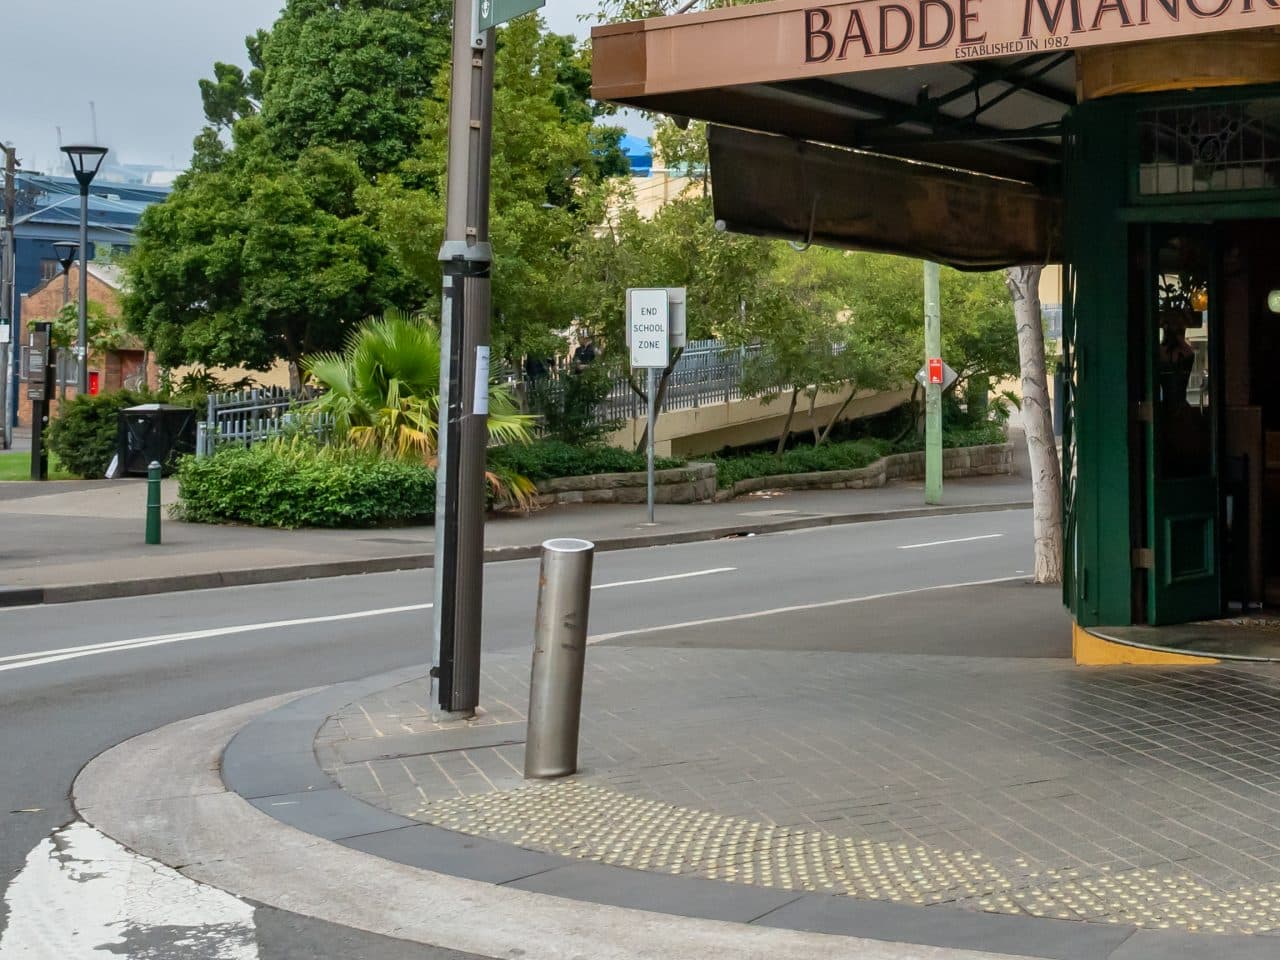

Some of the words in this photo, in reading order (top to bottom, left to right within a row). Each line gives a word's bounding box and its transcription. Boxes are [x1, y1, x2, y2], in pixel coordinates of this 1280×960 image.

[955, 41, 1024, 58] ESTABLISHED
[1026, 39, 1039, 50] IN
[1044, 36, 1069, 49] 1982
[641, 307, 657, 315] END
[633, 324, 664, 332] SCHOOL
[638, 340, 660, 348] ZONE
